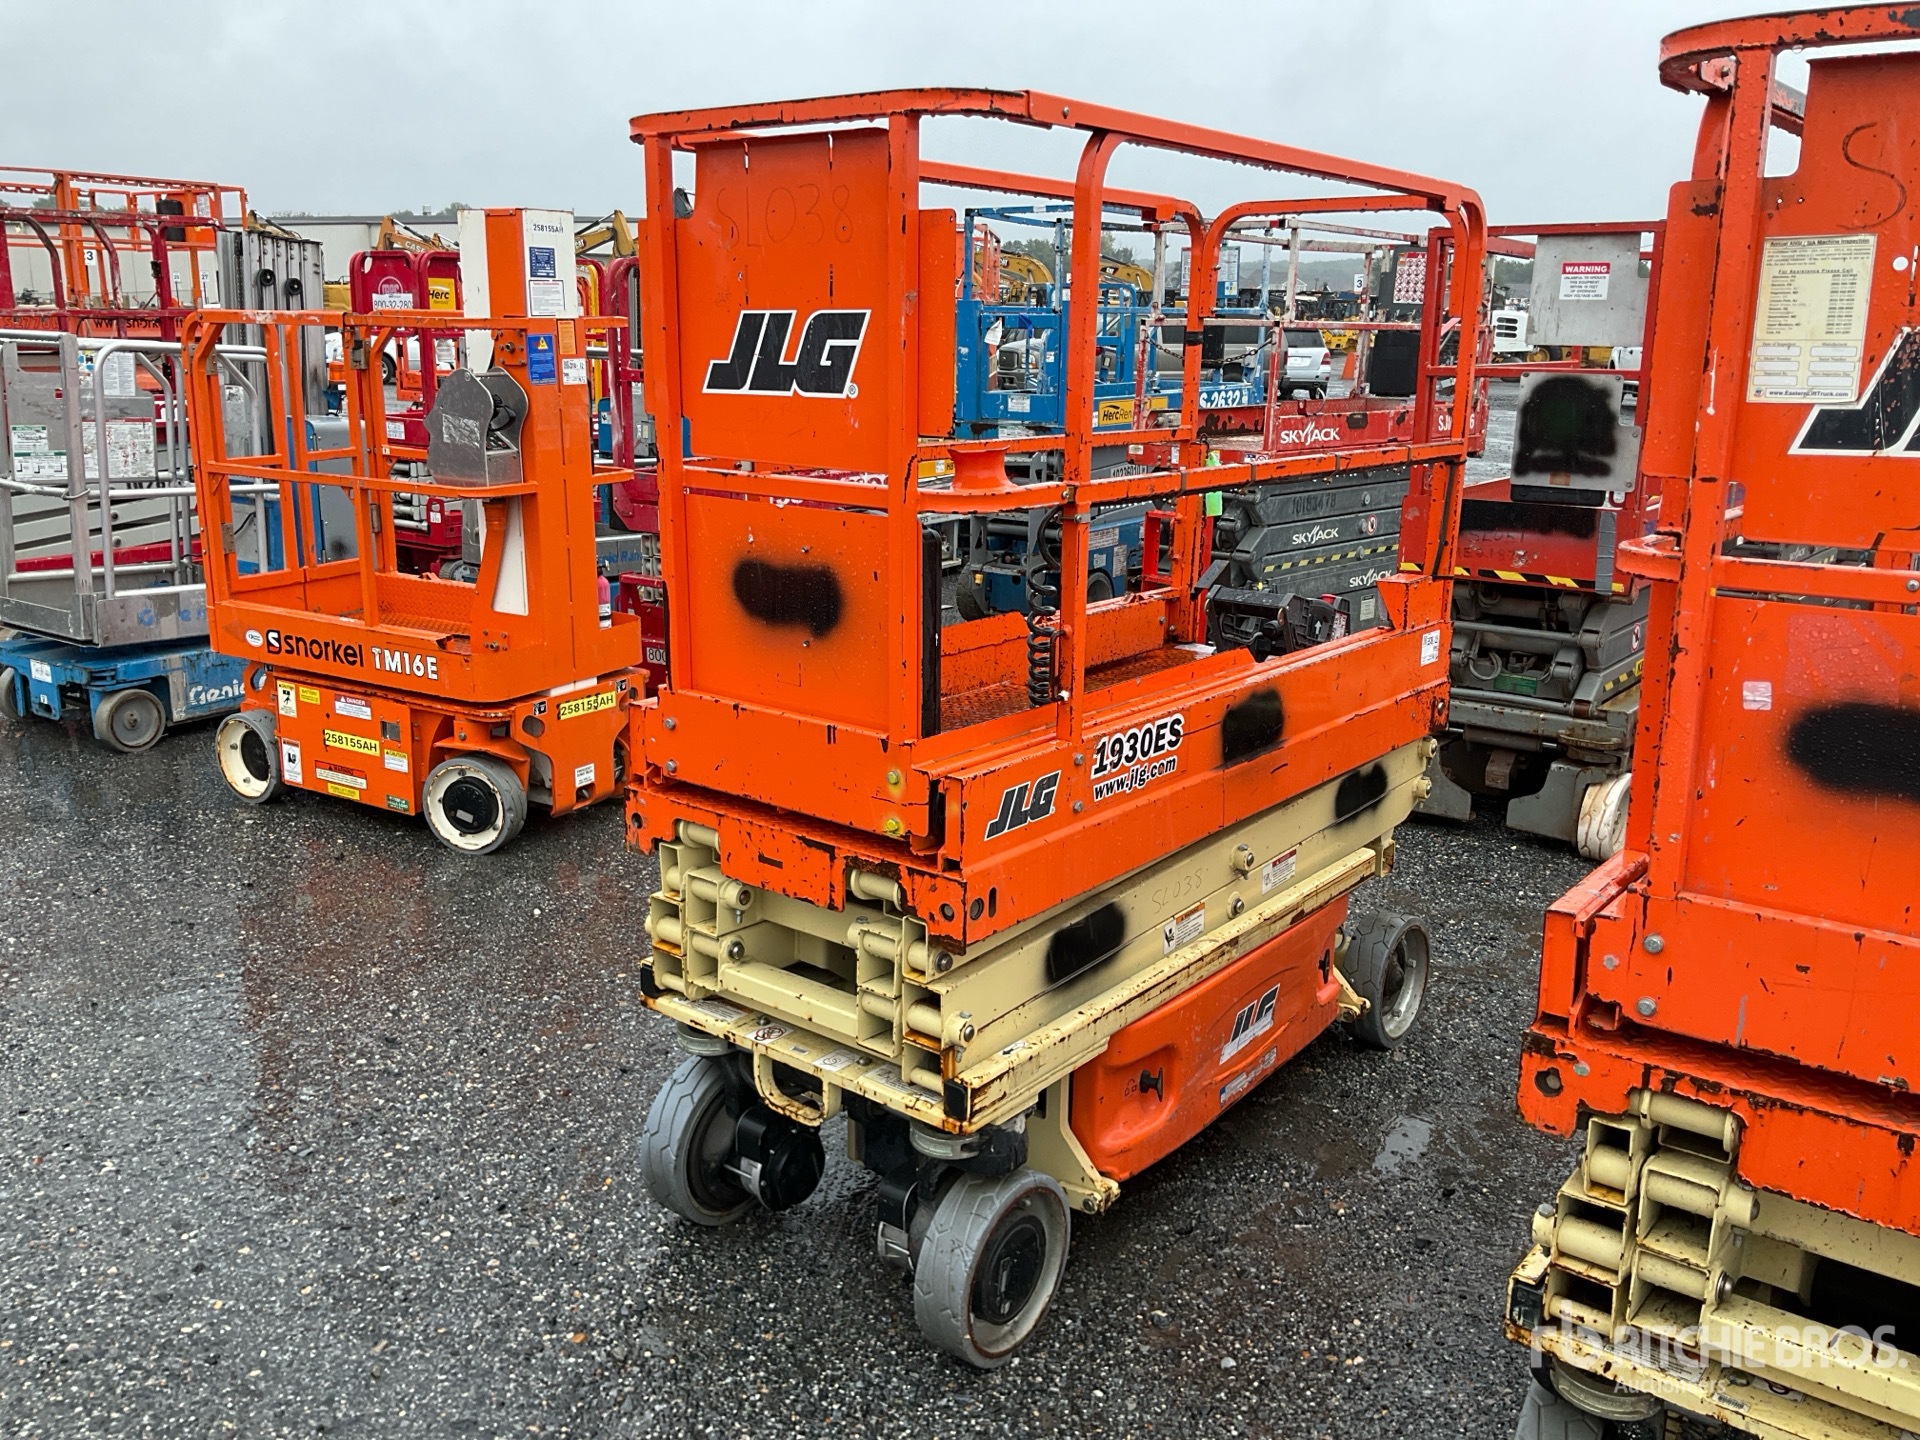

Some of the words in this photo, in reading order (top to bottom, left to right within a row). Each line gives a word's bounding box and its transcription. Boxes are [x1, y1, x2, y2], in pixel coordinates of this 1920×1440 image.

[86, 251, 94, 260] 3
[429, 289, 450, 300] Herc
[1356, 279, 1363, 289] 3
[702, 309, 871, 399] JLG
[1281, 421, 1340, 445] SKYJACK
[1292, 525, 1339, 545] SKYJACK
[284, 634, 364, 668] snorkel
[371, 645, 439, 681] TM16E
[346, 697, 366, 706] DANGER
[561, 695, 614, 716] 258155AH
[325, 732, 378, 752] 258155AH
[1092, 716, 1183, 777] 1930ES
[1093, 757, 1177, 801] www.jlg.com
[983, 769, 1062, 842] JLG
